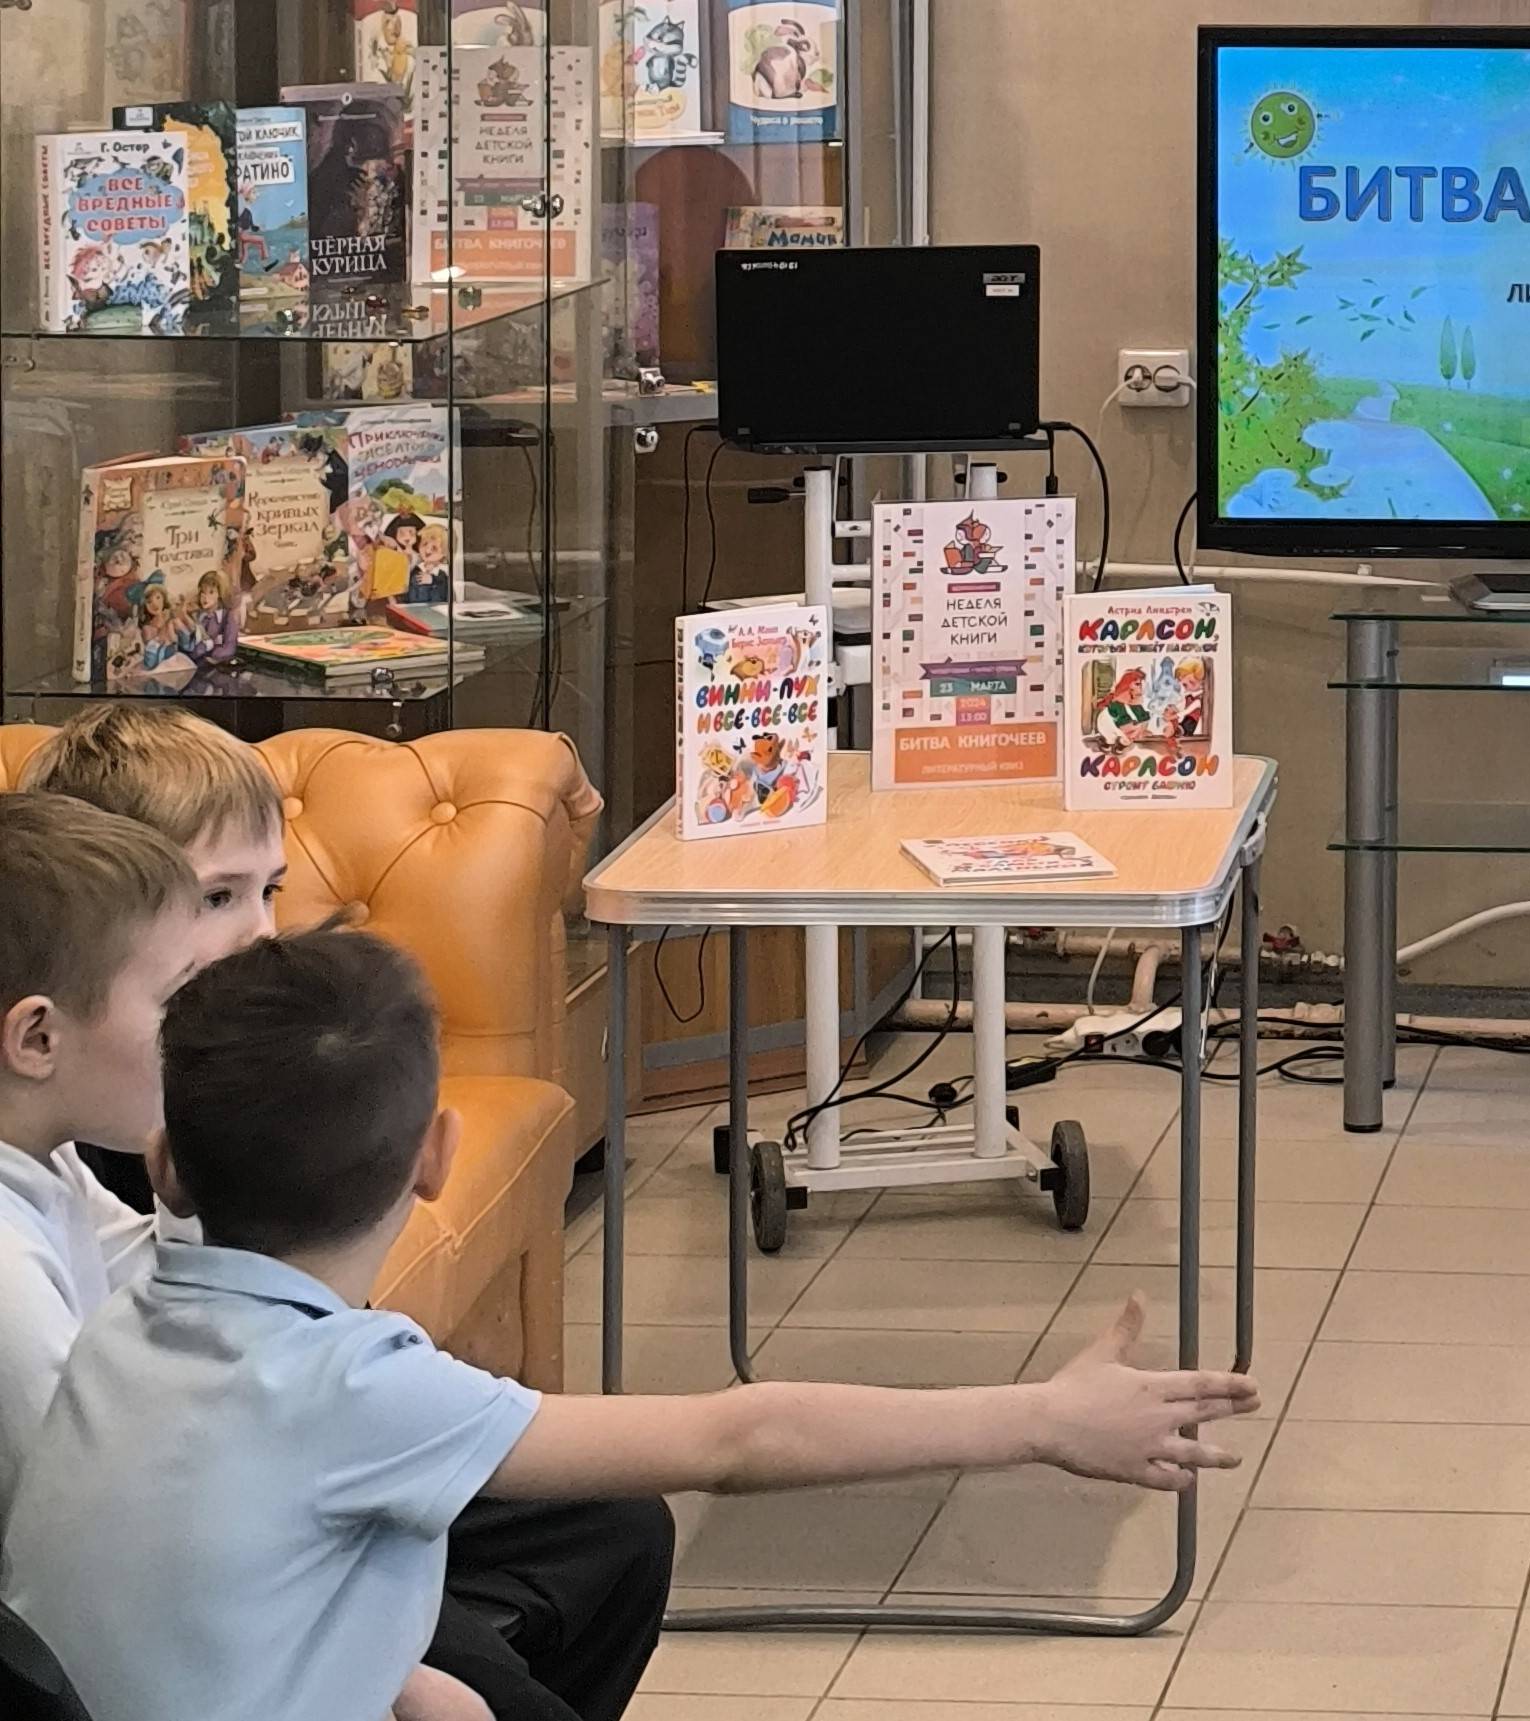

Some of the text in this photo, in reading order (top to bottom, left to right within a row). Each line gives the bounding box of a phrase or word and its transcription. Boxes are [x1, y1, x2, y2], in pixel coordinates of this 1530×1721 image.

[108, 177, 143, 192] ВСЕ
[77, 194, 173, 212] ВРЕДНЫЕ
[87, 216, 166, 232] СОВЕТЫ
[311, 234, 386, 256] ЧЁРНАЯ
[312, 254, 387, 276] КУРИЦА
[947, 598, 1001, 610] НЕДЕЛЯ
[941, 612, 1008, 628] ДЕТСКОЙ
[950, 632, 997, 645] КНИГИ
[1079, 618, 1219, 641] КАРЛСОН,
[696, 674, 820, 708] ВИННИ-ПУХ
[939, 680, 1007, 693] 23 МАРТА
[697, 700, 818, 734] И ВСЕ-ВСЕ-ВСЕ
[900, 732, 1046, 751] БИТВА КНИГОЧЕЕВ
[1080, 754, 1219, 778] КАРЛСОН
